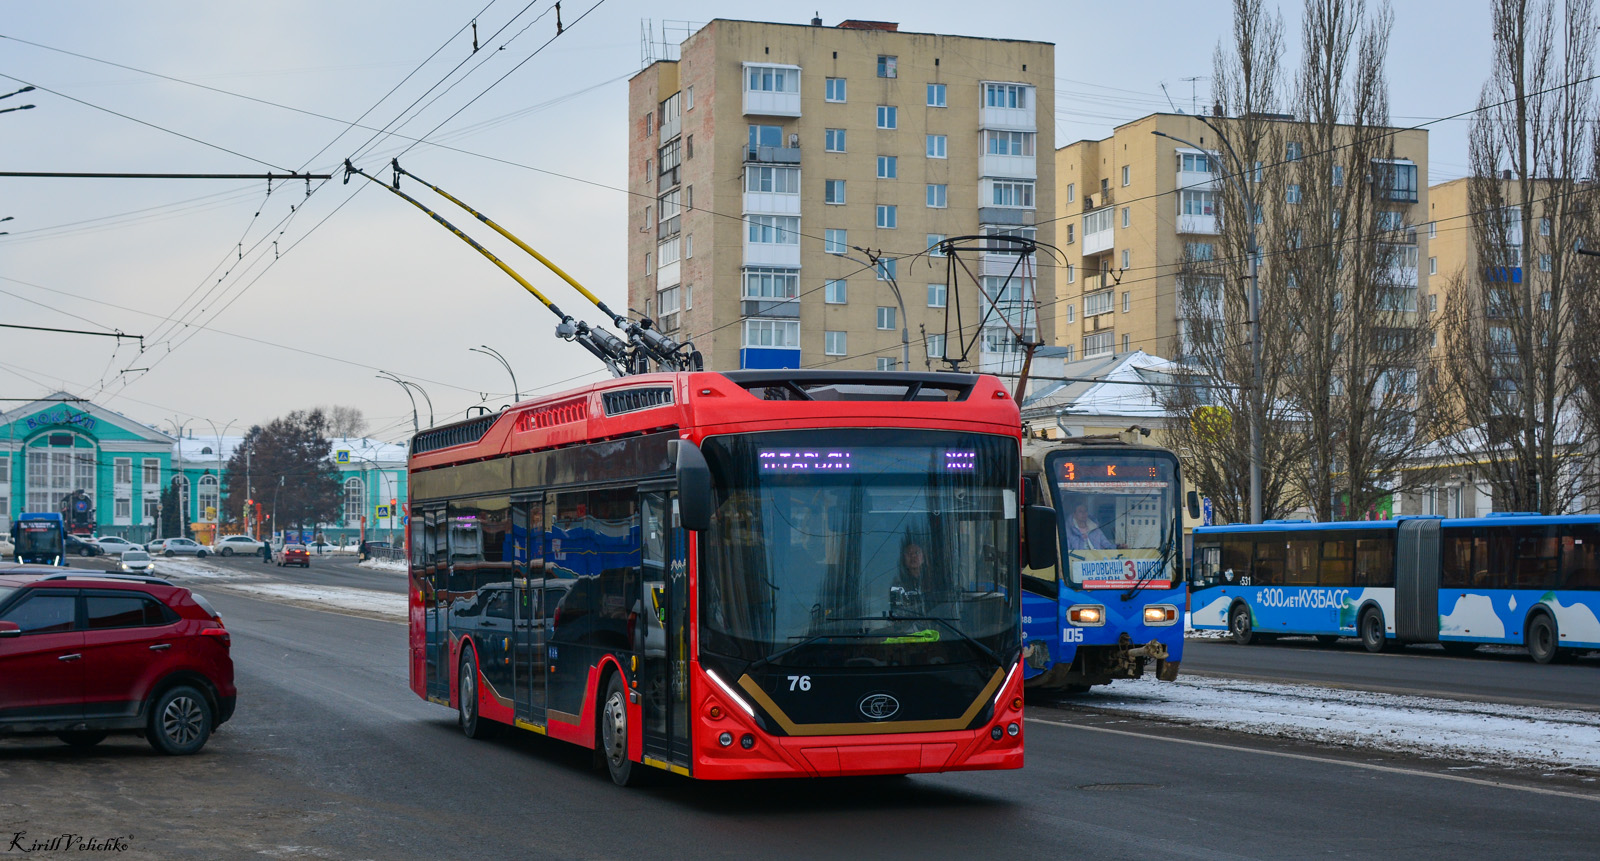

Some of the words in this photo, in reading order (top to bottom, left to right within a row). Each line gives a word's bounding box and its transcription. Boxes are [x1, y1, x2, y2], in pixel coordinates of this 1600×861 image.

[26, 410, 96, 430] ВОКЗАЛ
[1081, 560, 1123, 576] КИРОВСКИЙ
[1124, 560, 1136, 581] 3
[1063, 628, 1084, 643] 105
[787, 675, 811, 691] 76
